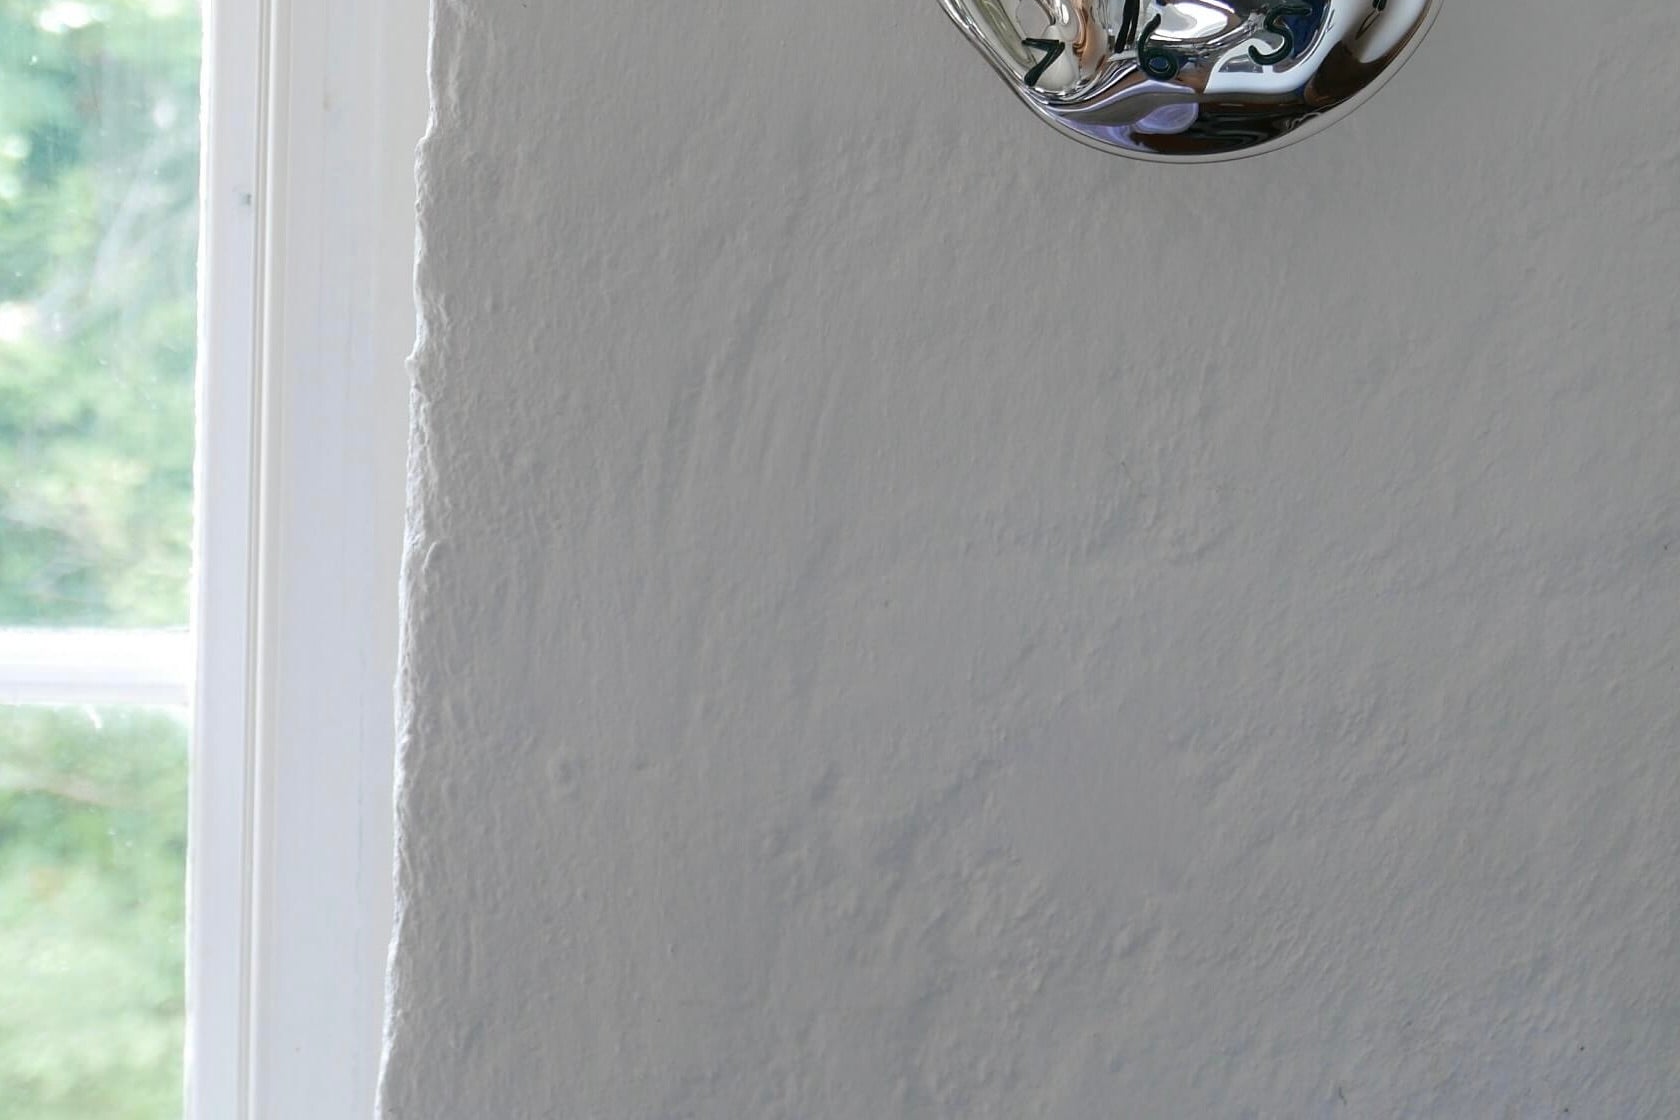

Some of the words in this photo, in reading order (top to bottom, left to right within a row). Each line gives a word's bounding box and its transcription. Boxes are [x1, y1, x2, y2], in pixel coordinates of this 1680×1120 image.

[1022, 37, 1066, 87] 7
[1138, 13, 1179, 81] 6
[1249, 5, 1312, 66] 5
